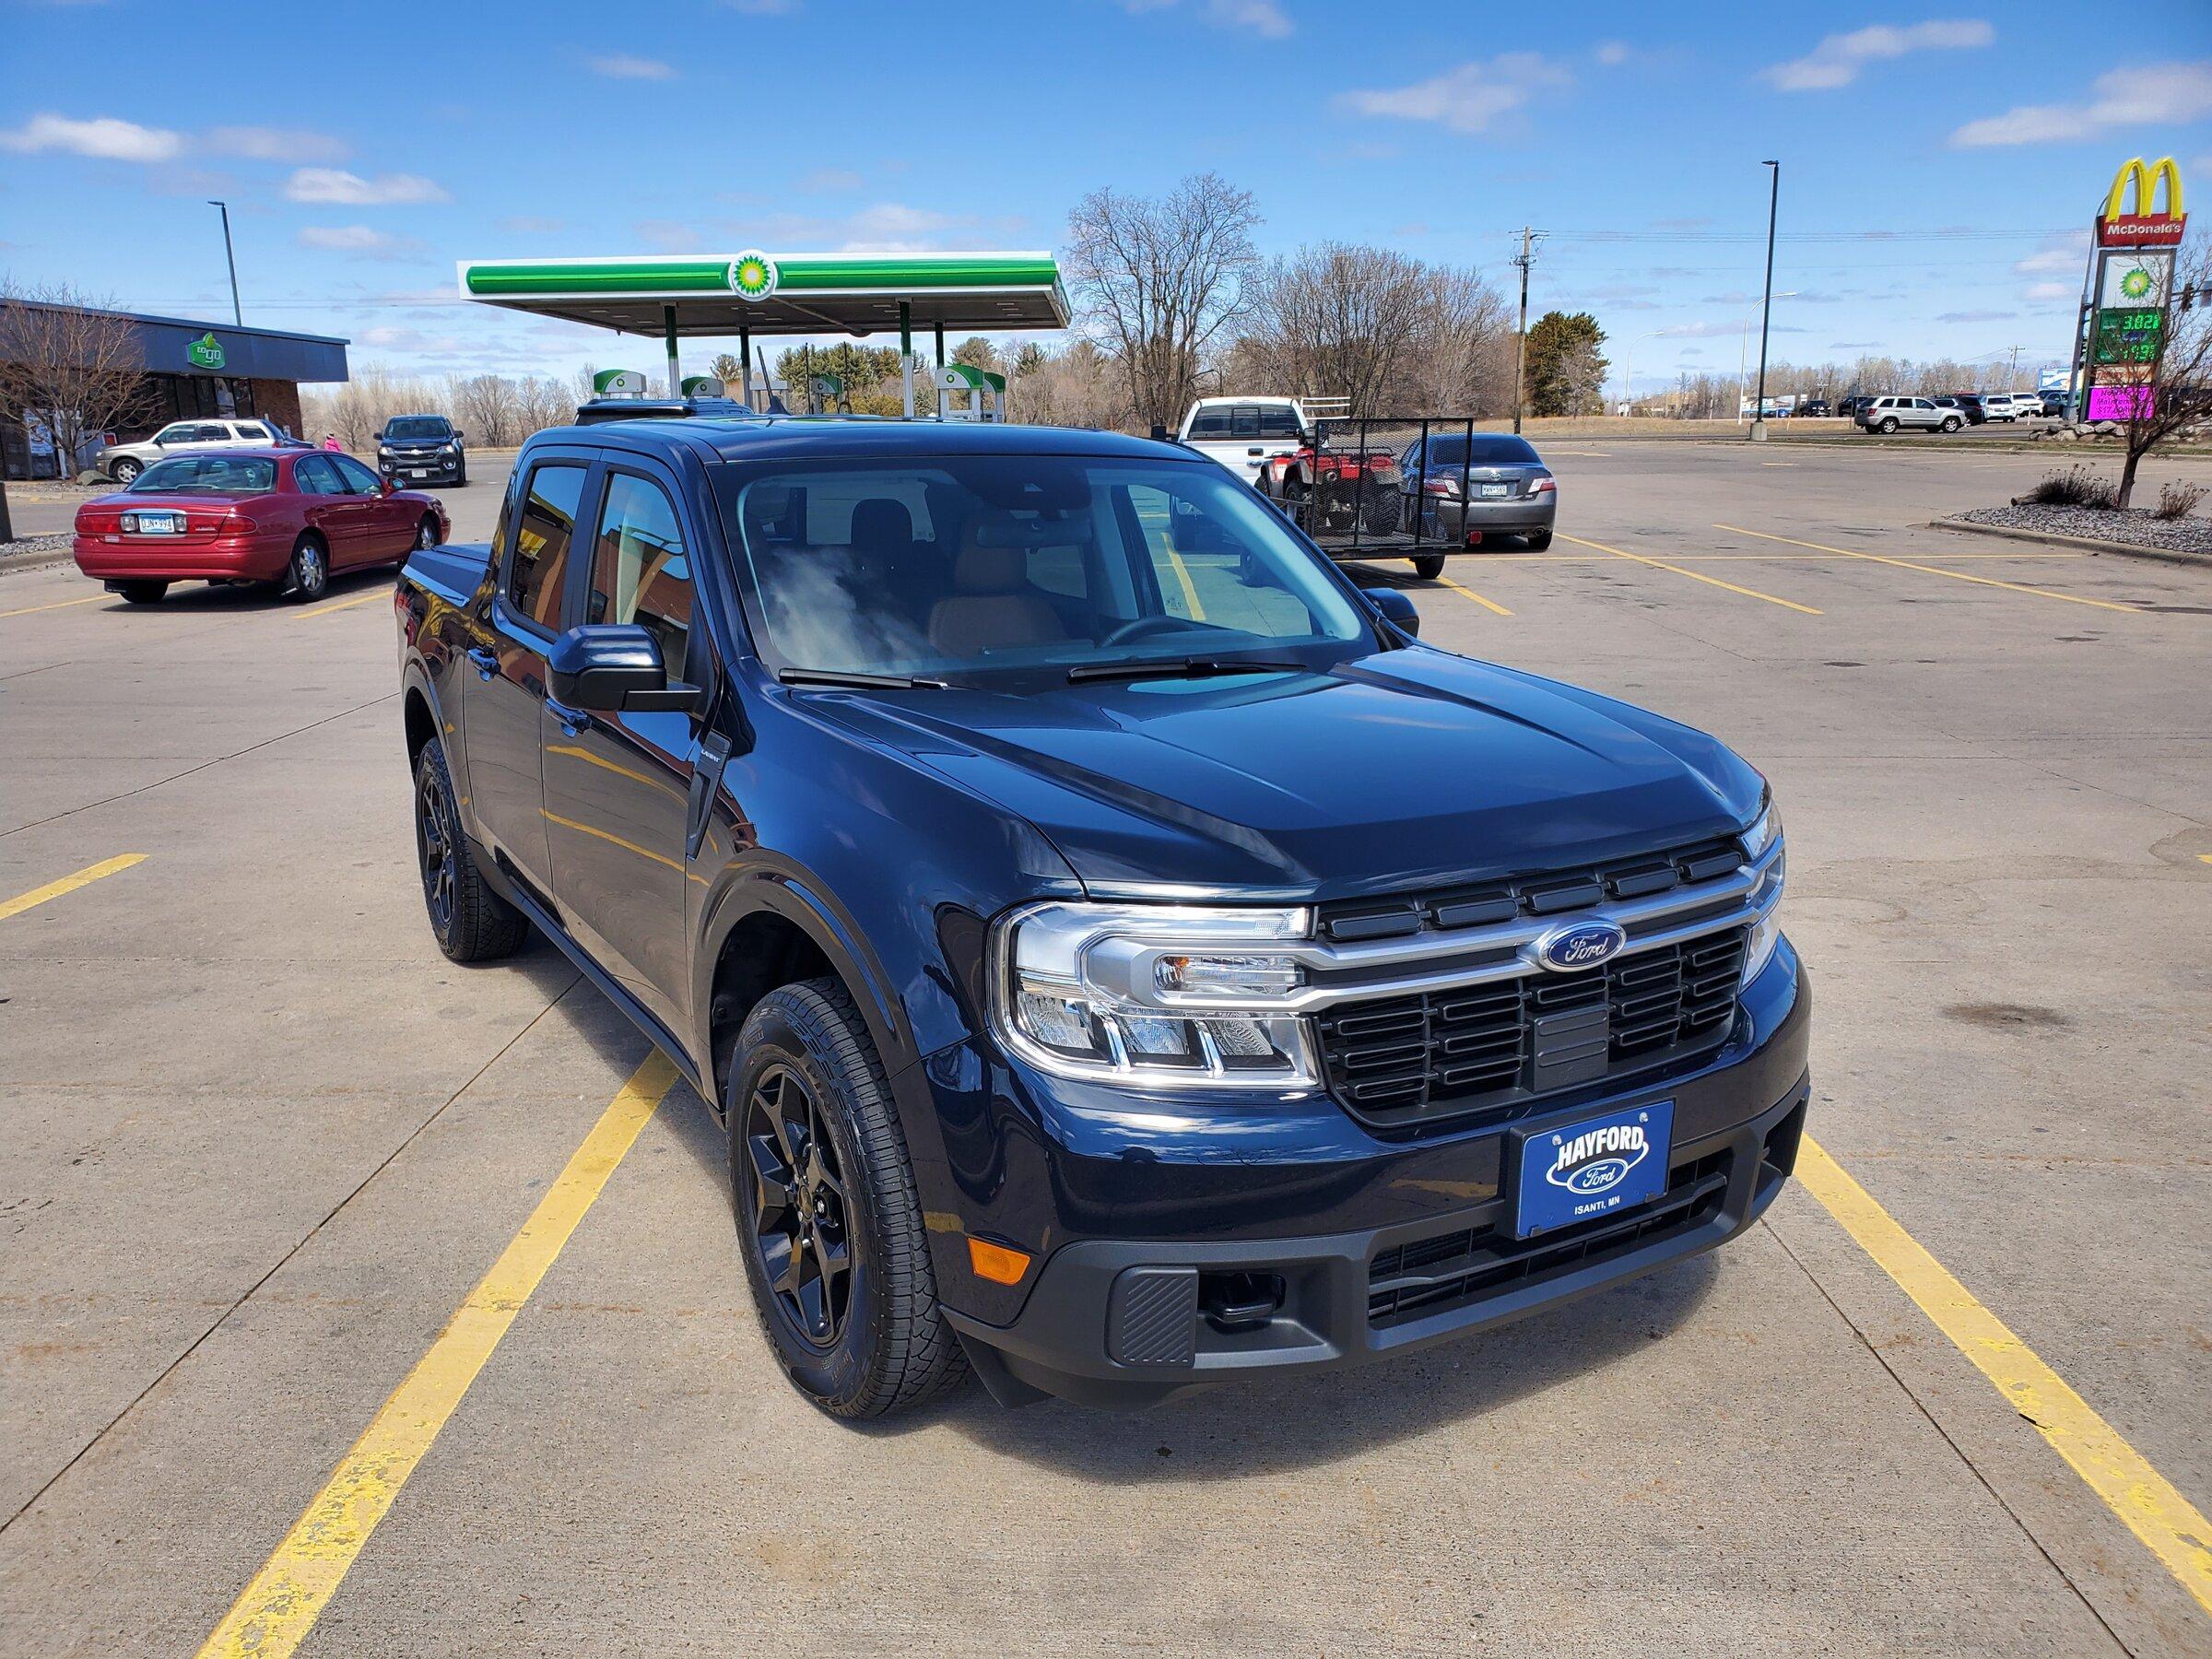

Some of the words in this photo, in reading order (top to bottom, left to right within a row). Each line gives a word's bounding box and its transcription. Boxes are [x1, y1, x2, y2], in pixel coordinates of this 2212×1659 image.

[2107, 223, 2182, 235] McDonald's
[205, 349, 221, 363] go
[1564, 934, 1609, 962] Ford
[1557, 1125, 1644, 1171] HAYFORD
[1582, 1165, 1617, 1188] Ford
[1574, 1200, 1606, 1216] ISANTI,
[1607, 1194, 1620, 1207] MN
